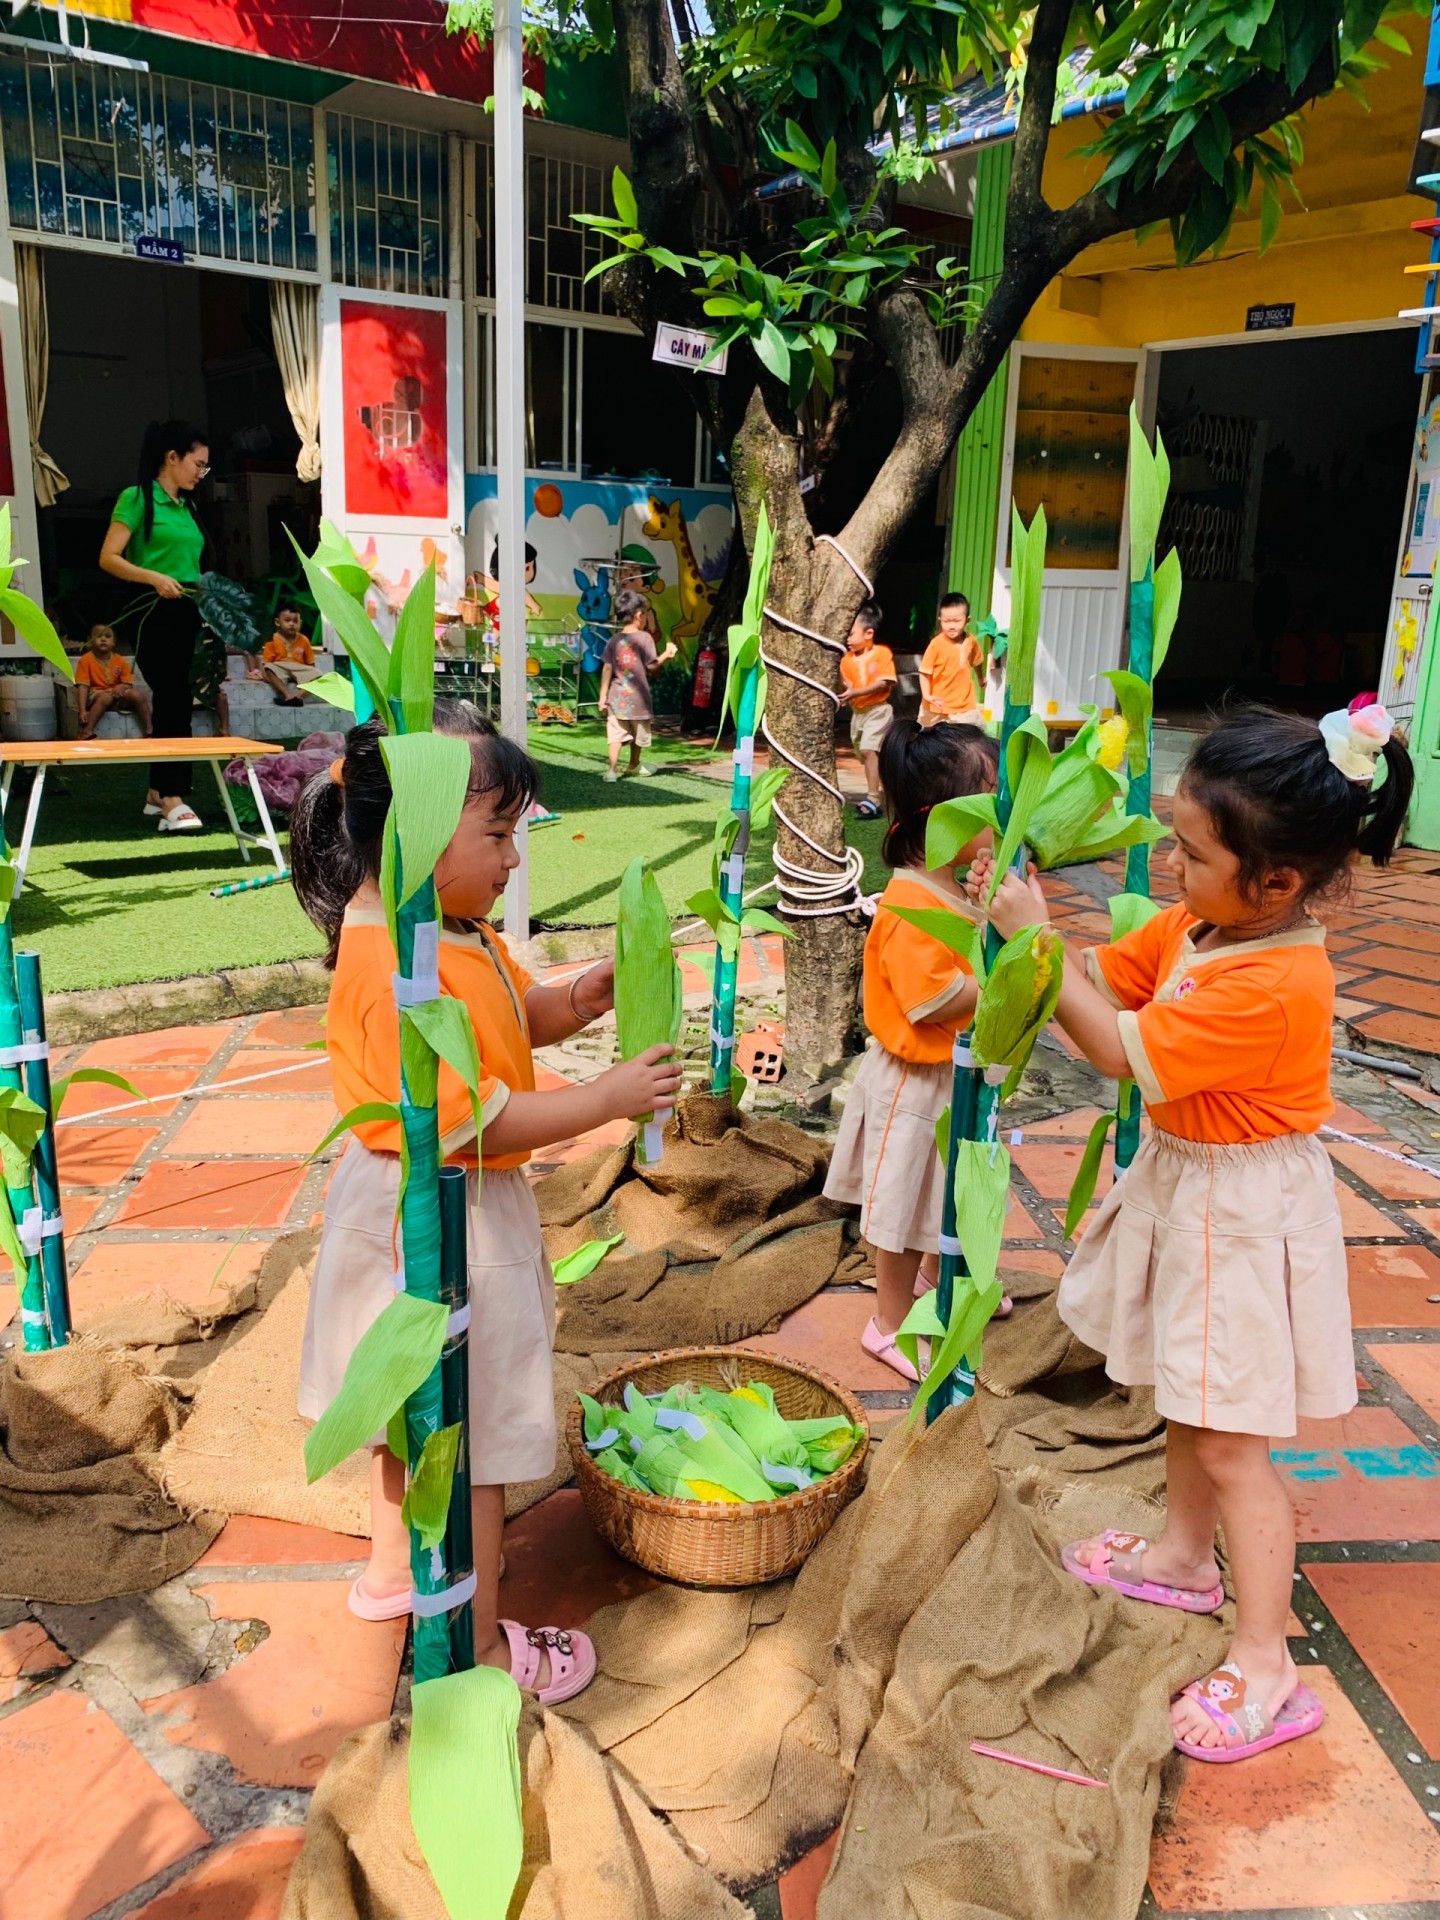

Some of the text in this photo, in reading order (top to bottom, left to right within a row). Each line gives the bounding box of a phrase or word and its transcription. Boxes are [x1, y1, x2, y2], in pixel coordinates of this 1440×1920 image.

[141, 240, 179, 259] MẦM 2
[670, 338, 691, 357] CÂY
